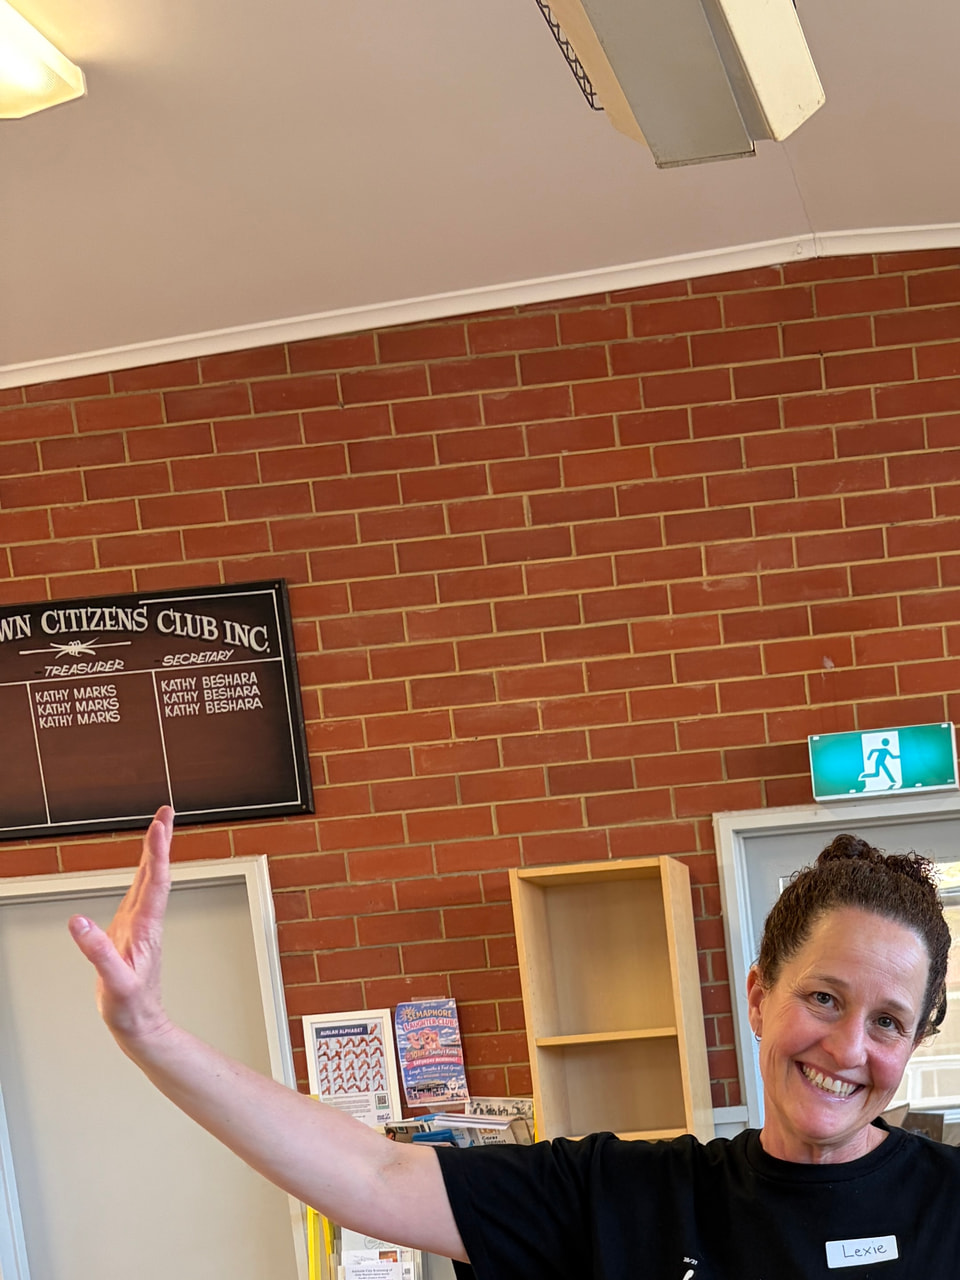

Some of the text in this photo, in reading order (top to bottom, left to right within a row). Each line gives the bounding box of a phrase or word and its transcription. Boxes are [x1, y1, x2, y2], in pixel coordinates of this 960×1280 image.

[41, 606, 149, 634] CITIZENS
[157, 608, 219, 640] CLUB
[223, 620, 271, 653] INC.
[162, 649, 234, 666] SECRETARY
[44, 659, 125, 677] TREASURER
[161, 671, 258, 692] KATHY BESHARA
[35, 684, 117, 703] KATHY MARKS
[163, 685, 261, 704] KATHY BESHARA
[37, 697, 120, 716] KATHY MARKS
[164, 697, 264, 718] KATHY BESHARA
[39, 710, 121, 729] KATHY MARKS
[406, 1009, 452, 1021] SEMAPHORE
[842, 1242, 887, 1259] Lexie
